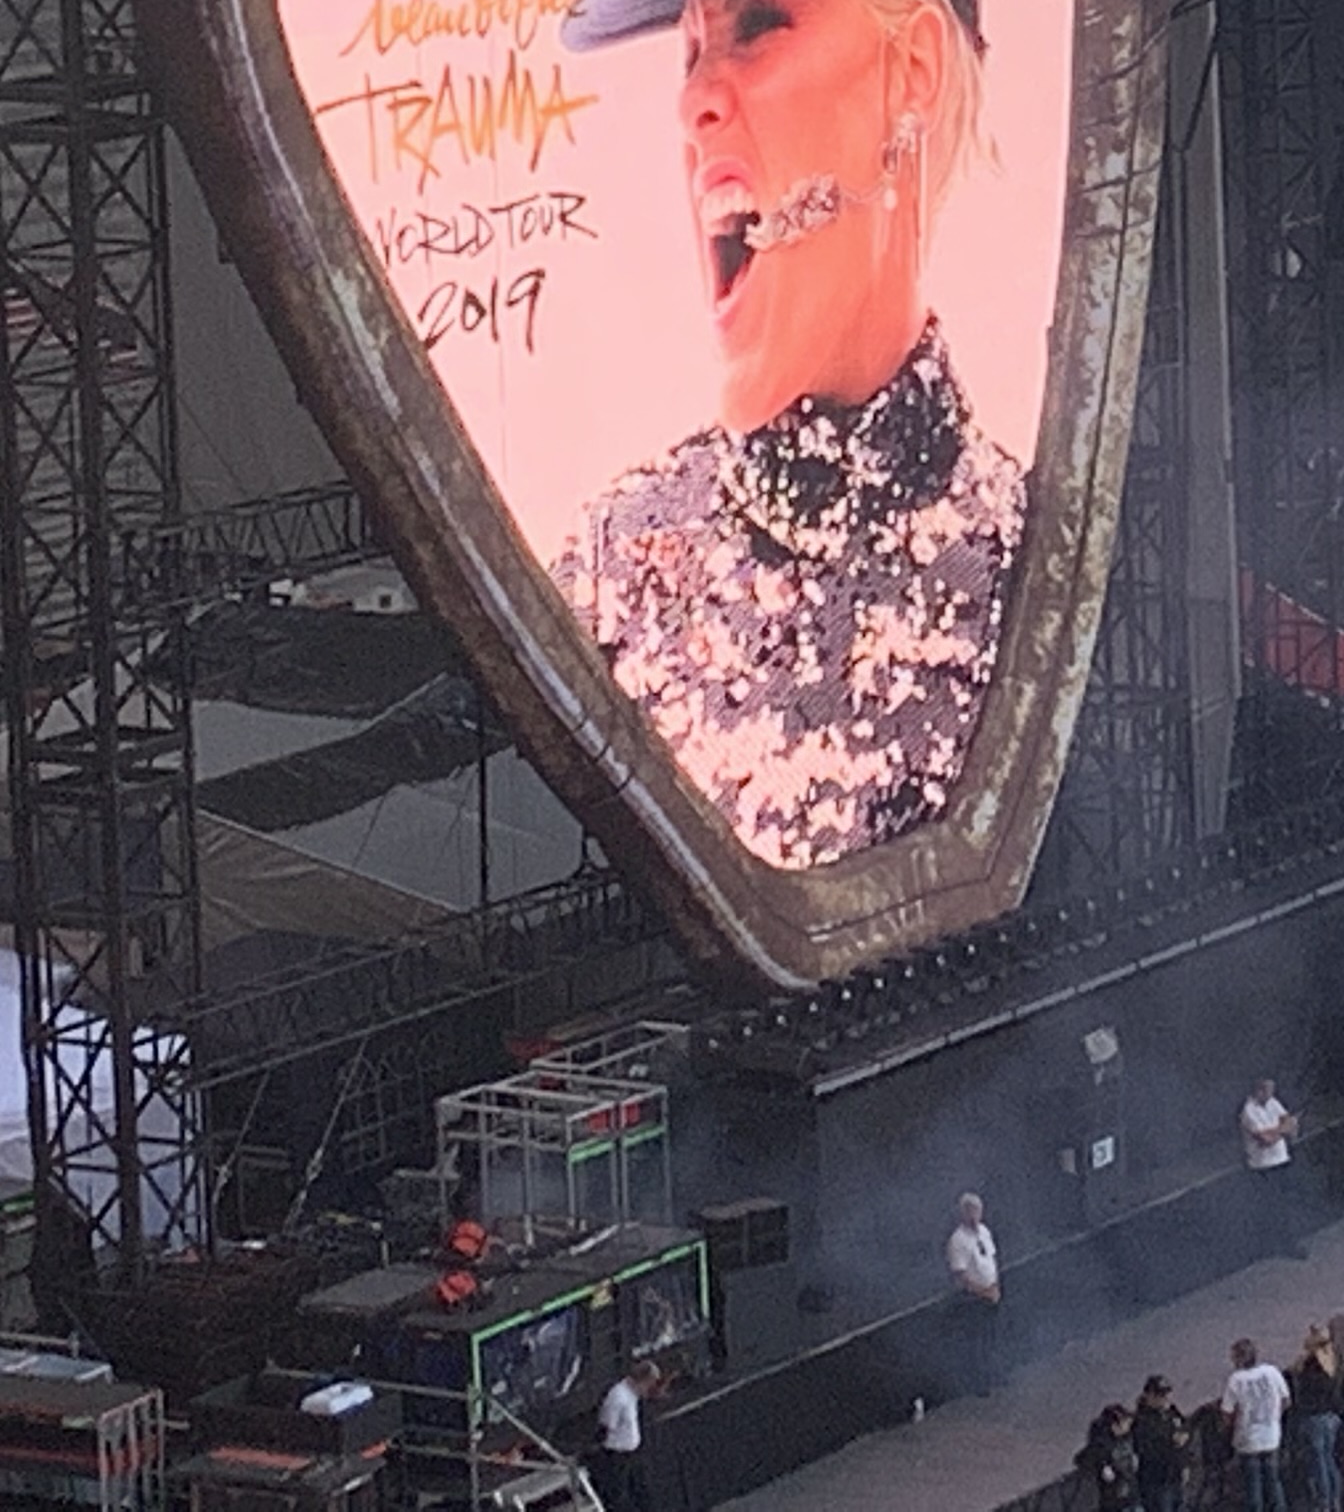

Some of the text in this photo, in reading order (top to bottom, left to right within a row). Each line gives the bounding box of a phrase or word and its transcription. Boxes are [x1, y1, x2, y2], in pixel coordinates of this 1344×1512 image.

[315, 48, 600, 195] TRAUMA
[489, 191, 599, 249] TOUR
[417, 268, 546, 355] 2019
